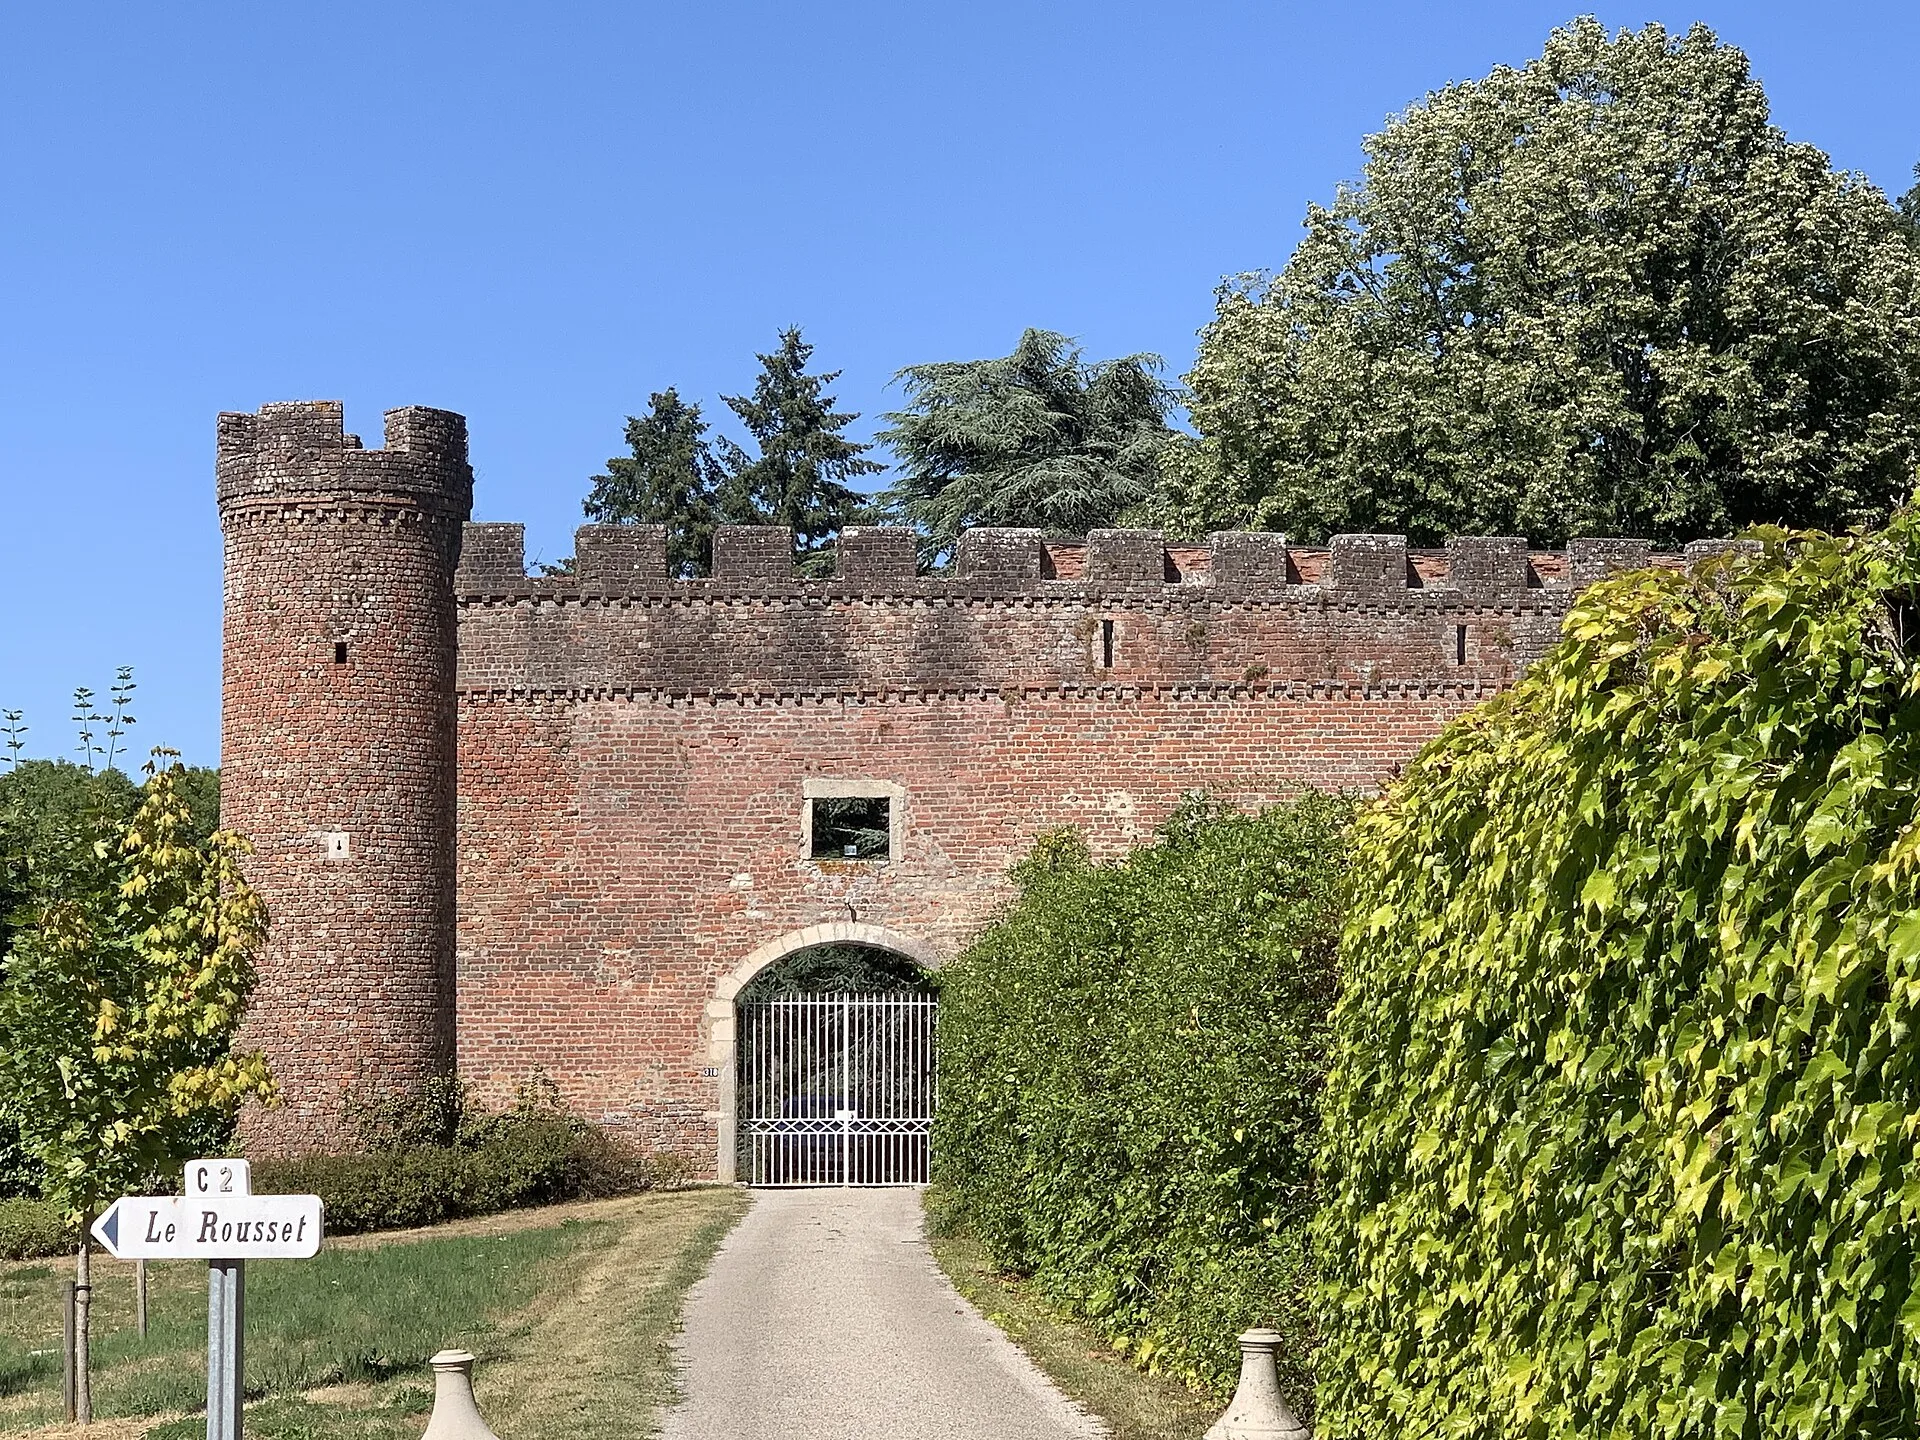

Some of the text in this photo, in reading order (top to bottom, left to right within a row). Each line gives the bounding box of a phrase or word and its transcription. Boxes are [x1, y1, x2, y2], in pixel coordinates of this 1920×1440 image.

[197, 1166, 233, 1193] C 2
[144, 1210, 307, 1243] Le Rousset
